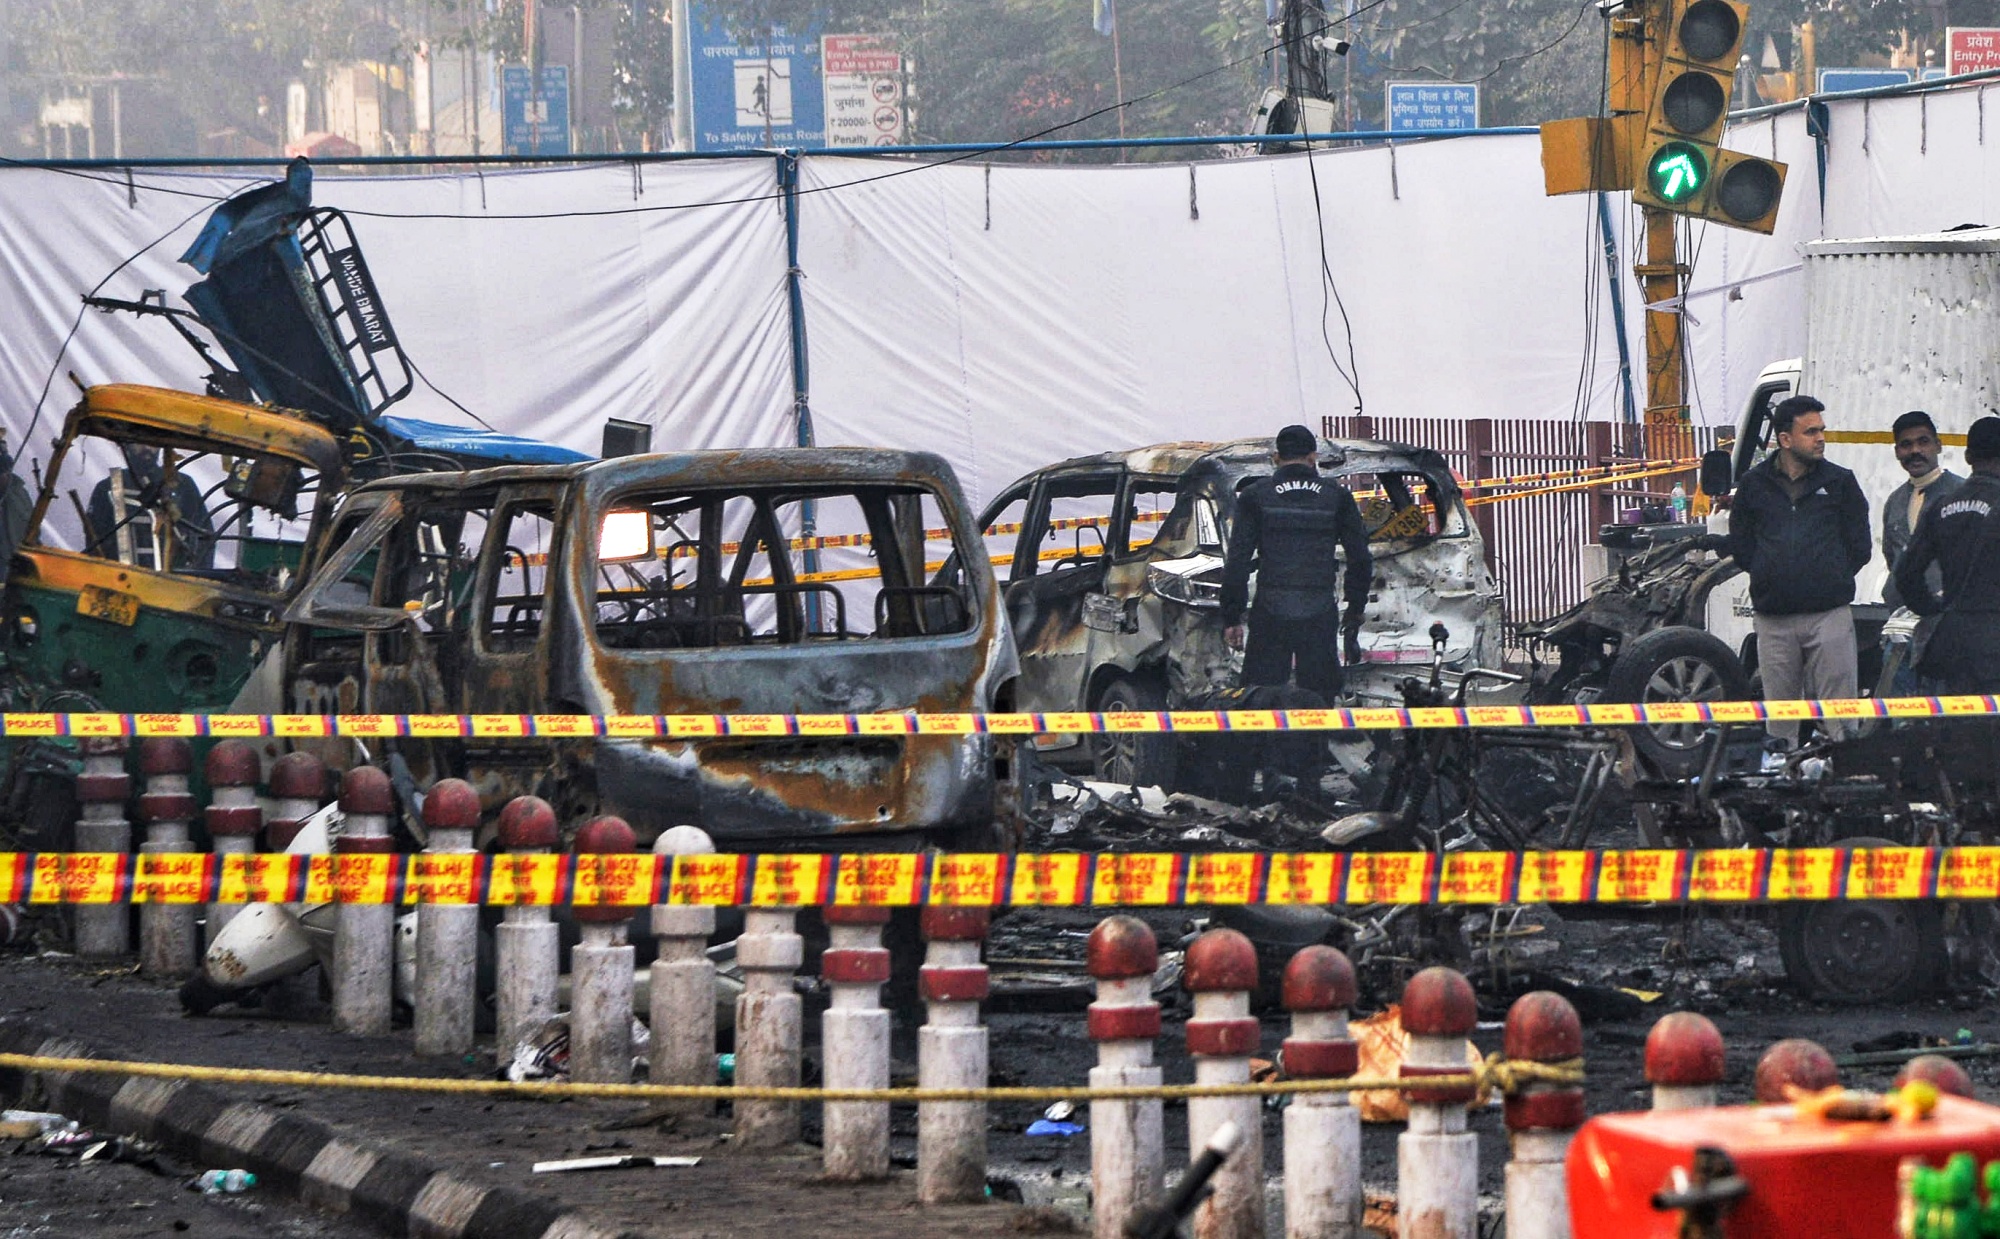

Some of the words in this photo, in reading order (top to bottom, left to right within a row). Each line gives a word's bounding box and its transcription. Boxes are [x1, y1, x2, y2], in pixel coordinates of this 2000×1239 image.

[1966, 33, 1993, 48] प्रवेश
[1954, 50, 1983, 64] Entry
[704, 132, 719, 143] To
[722, 130, 756, 143] Safely
[760, 131, 793, 142] Coss
[834, 135, 868, 145] Penalty
[340, 254, 366, 296] VANDE
[1712, 706, 1752, 715] POLICE
[1888, 702, 1927, 710] POLICE
[1355, 713, 1396, 722] POLICE
[1534, 710, 1575, 719] POLICE
[7, 720, 54, 729] POLICE
[213, 720, 257, 729] POLICE
[413, 721, 457, 730] POLICE
[608, 721, 652, 730] POLICE
[801, 719, 843, 729] POLICE
[988, 718, 1029, 727] POLICE
[1172, 716, 1214, 725] POLICE
[1442, 880, 1496, 893] POLICE
[1691, 877, 1746, 890] POLICE
[1941, 875, 1994, 888] POLICE
[136, 882, 198, 896] POLICE
[407, 883, 467, 897] POLICE
[673, 883, 731, 897] POLICE
[933, 883, 990, 896] POLICE
[1188, 882, 1245, 895] POLICE
